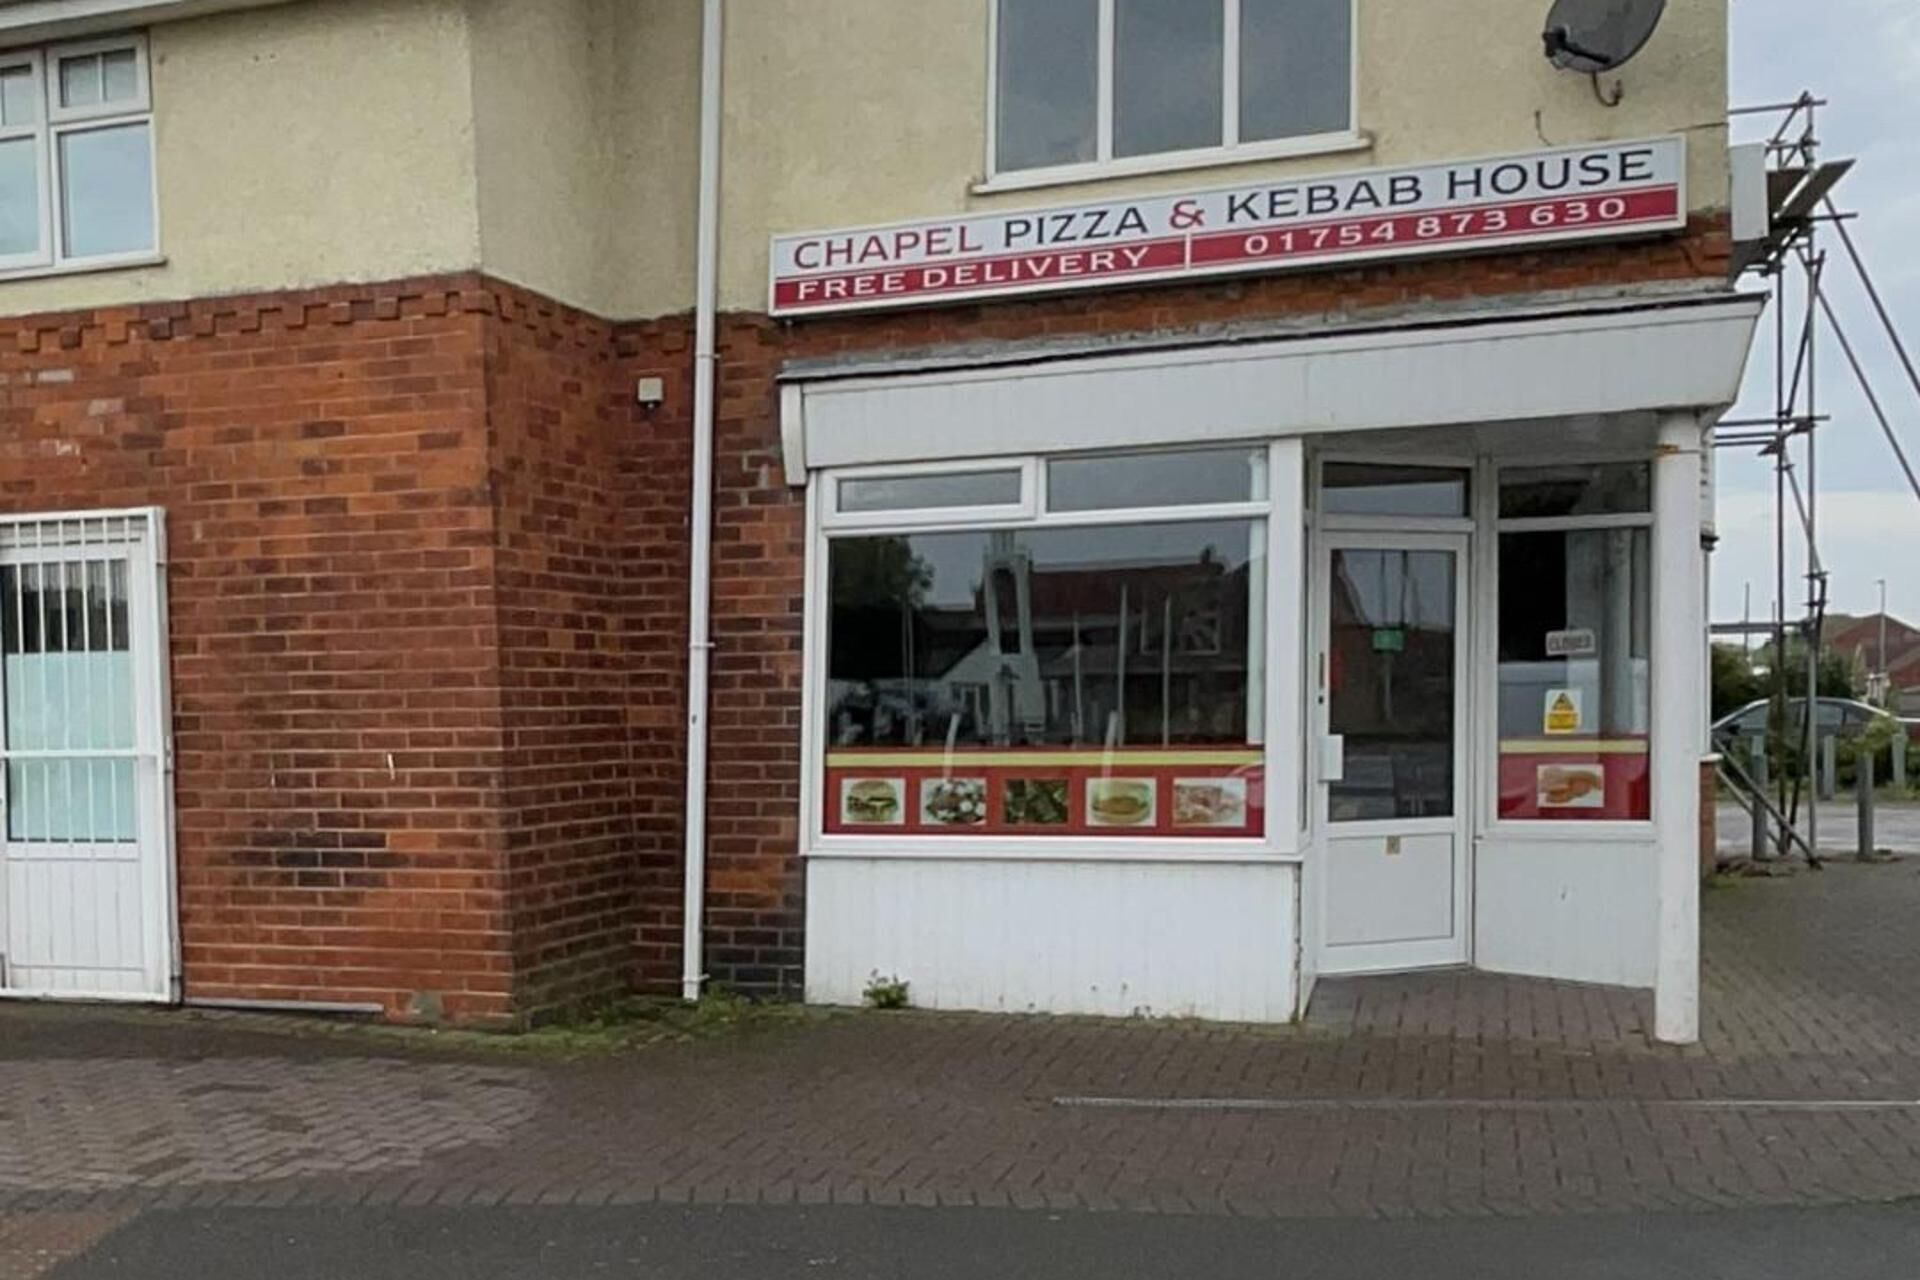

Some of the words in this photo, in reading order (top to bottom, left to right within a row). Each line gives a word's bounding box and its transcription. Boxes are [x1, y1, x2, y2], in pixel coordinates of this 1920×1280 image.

[794, 226, 982, 269] CHAPEL
[1005, 207, 1148, 248] PIZZA
[1170, 200, 1205, 228] &
[1227, 175, 1422, 221] KEBAB
[1448, 148, 1653, 200] HOUSE
[1244, 222, 1395, 255] 01754
[1416, 209, 1507, 238] 873
[1530, 198, 1626, 226] 630
[799, 272, 905, 300] FREE
[923, 247, 1151, 288] DELIVERY
